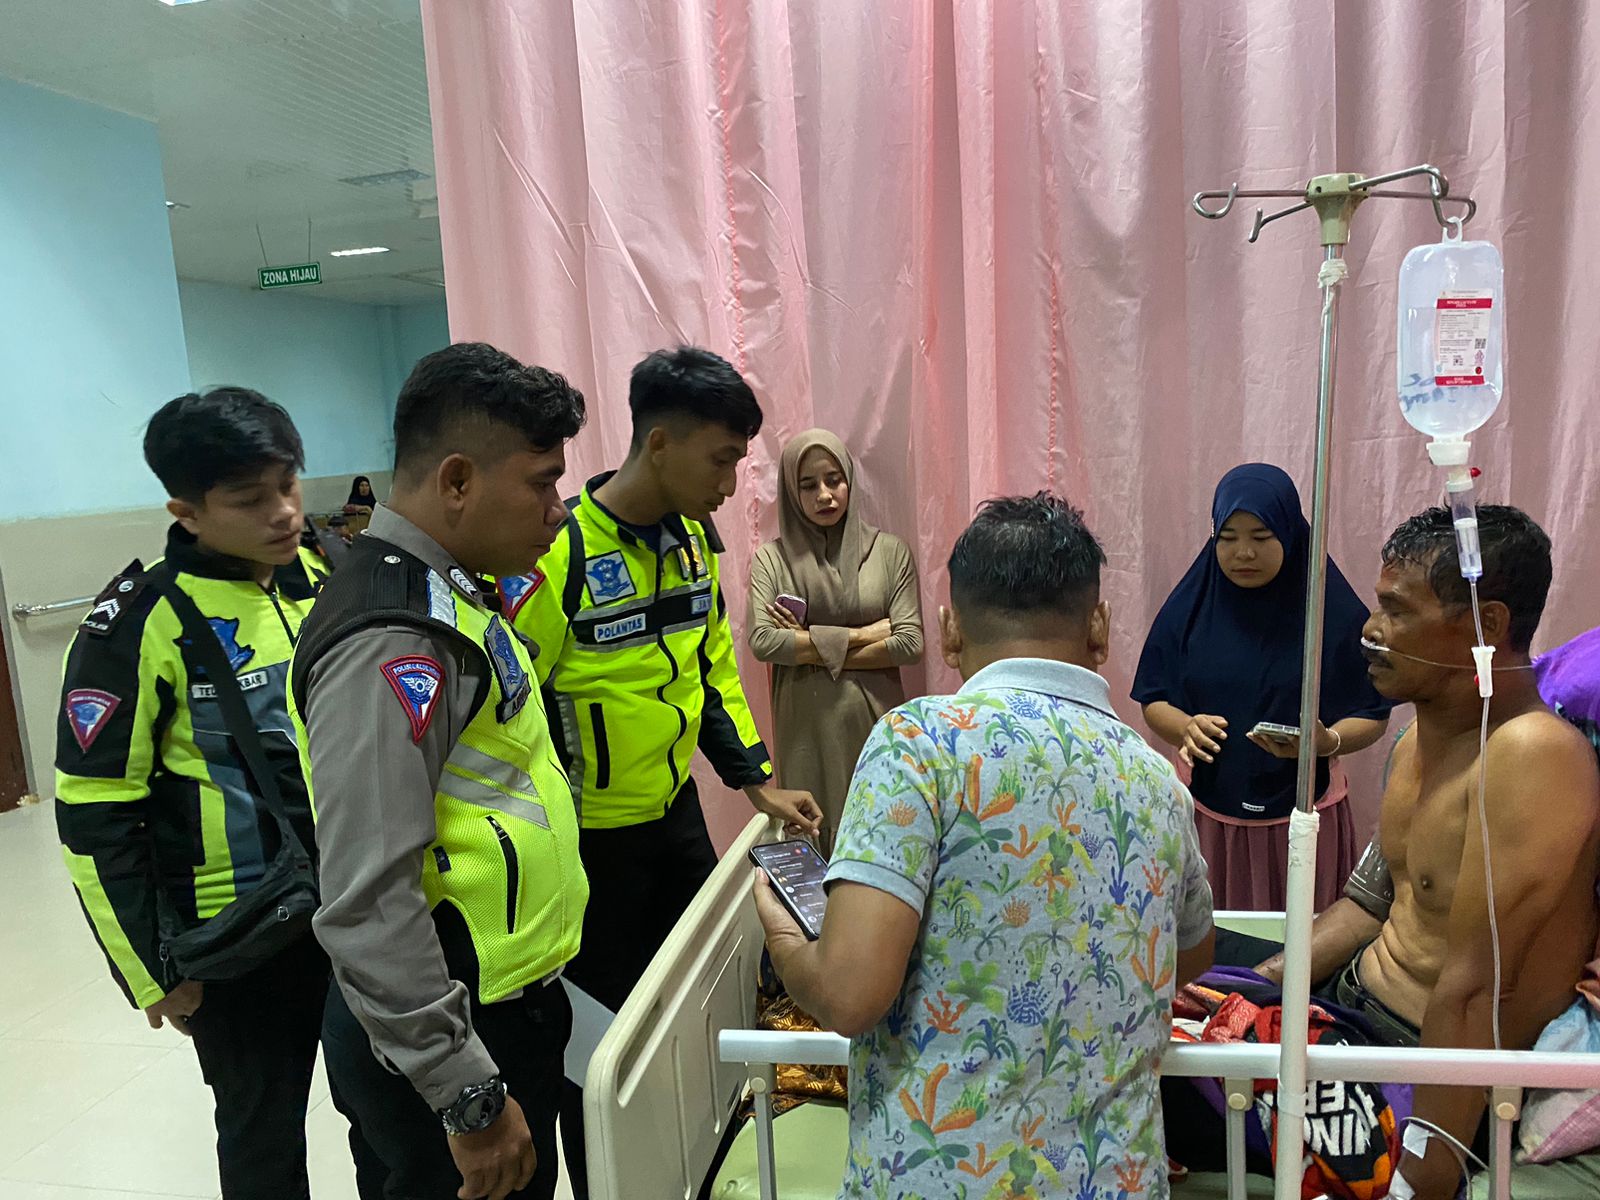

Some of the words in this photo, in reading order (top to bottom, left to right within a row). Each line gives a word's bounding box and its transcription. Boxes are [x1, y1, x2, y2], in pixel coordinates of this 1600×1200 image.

[263, 270, 289, 285] ZONA
[289, 267, 317, 282] HIJAU
[597, 617, 643, 639] POLANTAS
[240, 674, 262, 689] BAR
